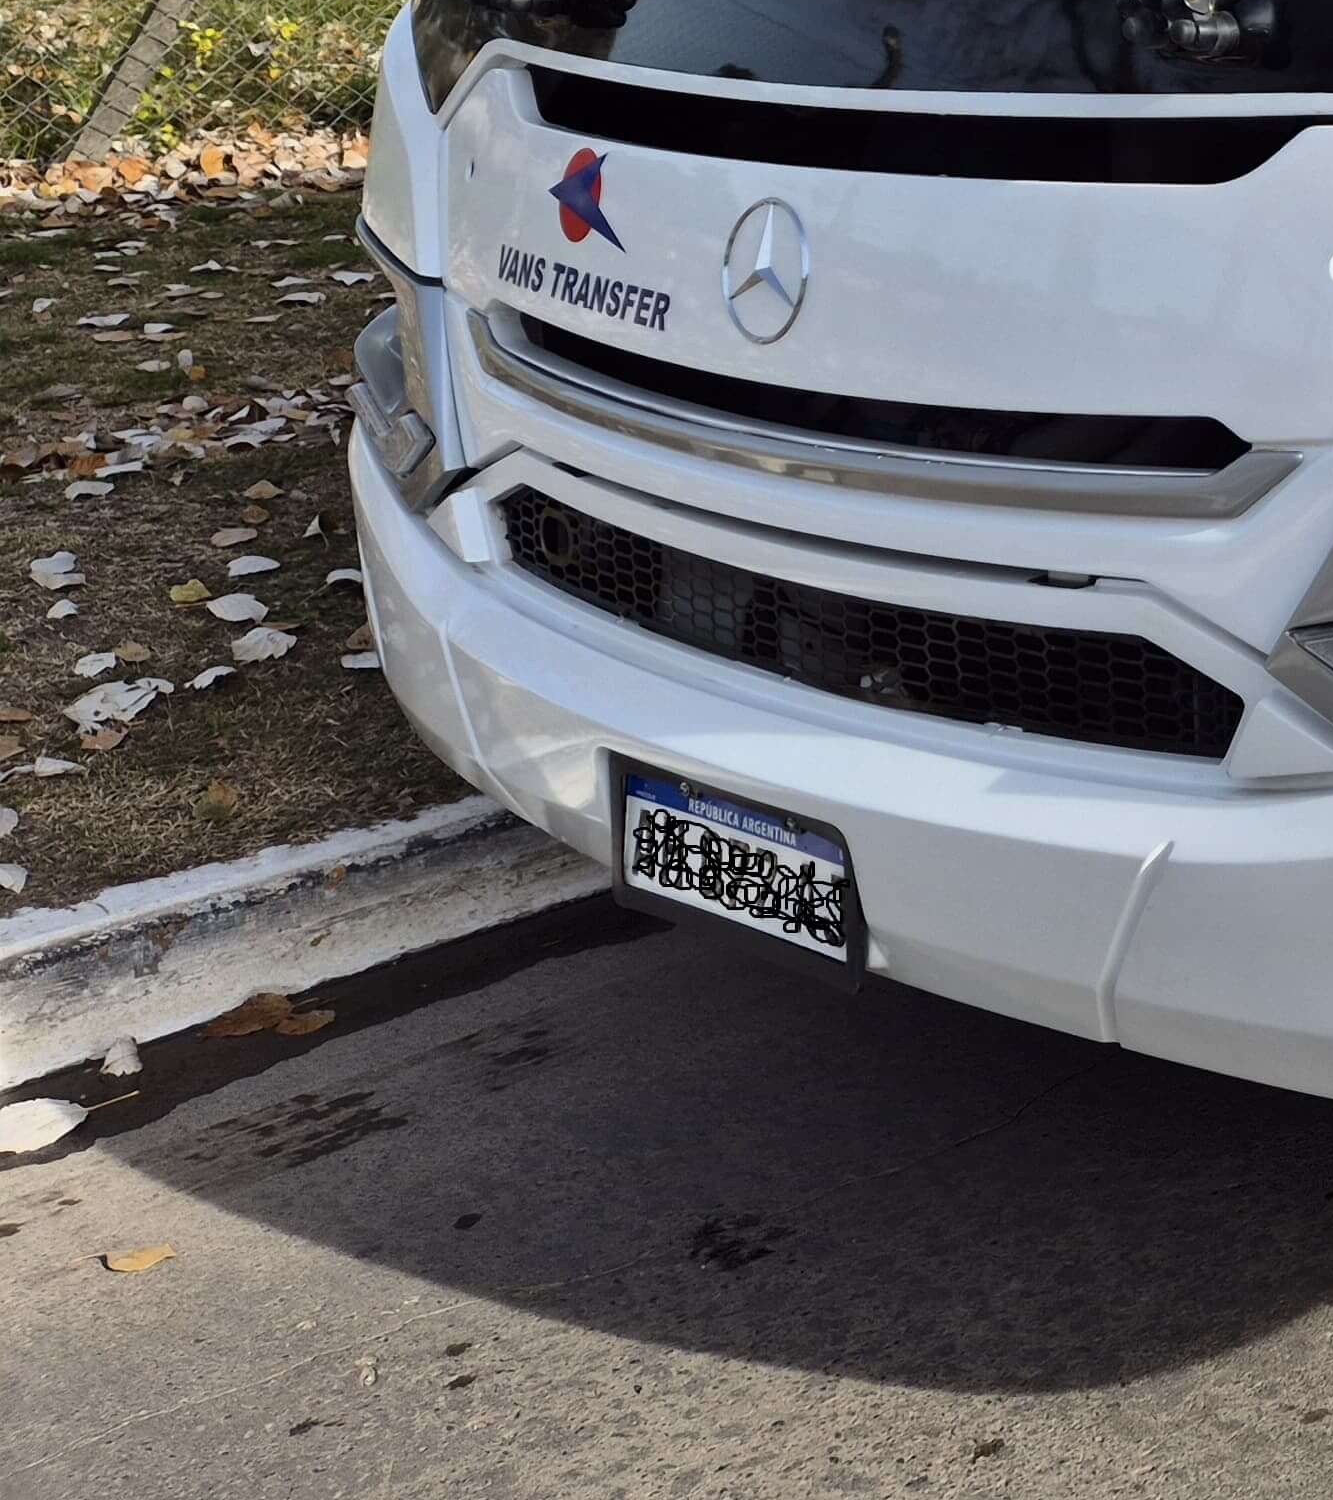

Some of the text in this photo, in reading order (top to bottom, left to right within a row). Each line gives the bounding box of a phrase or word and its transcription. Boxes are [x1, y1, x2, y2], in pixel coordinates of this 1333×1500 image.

[497, 244, 671, 331] VANS TRANSFER
[688, 798, 797, 847] REPÚBLICA ARGENTINA
